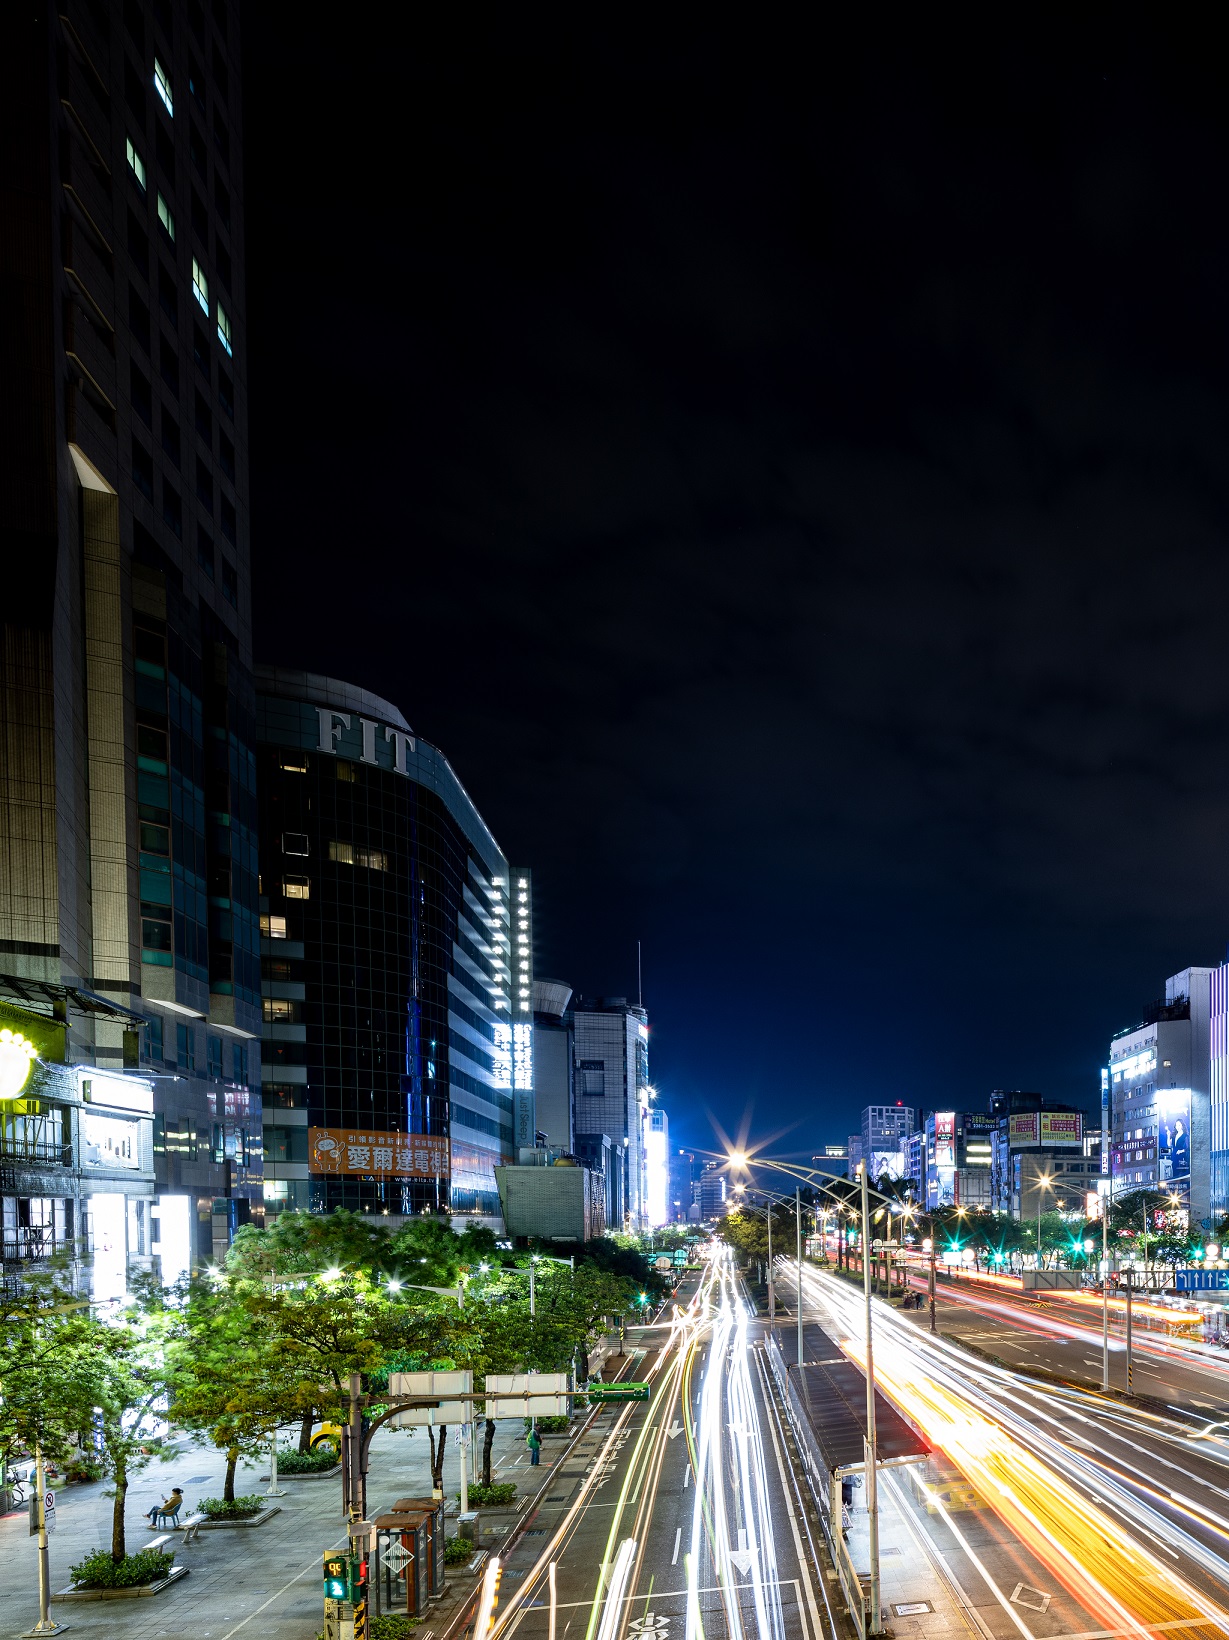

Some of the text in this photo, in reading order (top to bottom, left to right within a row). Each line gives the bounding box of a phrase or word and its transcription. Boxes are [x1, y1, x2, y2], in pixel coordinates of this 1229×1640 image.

[315, 706, 416, 777] FIT
[520, 1093, 529, 1141] Just Sleep
[394, 1176, 435, 1184] www.elta.tv
